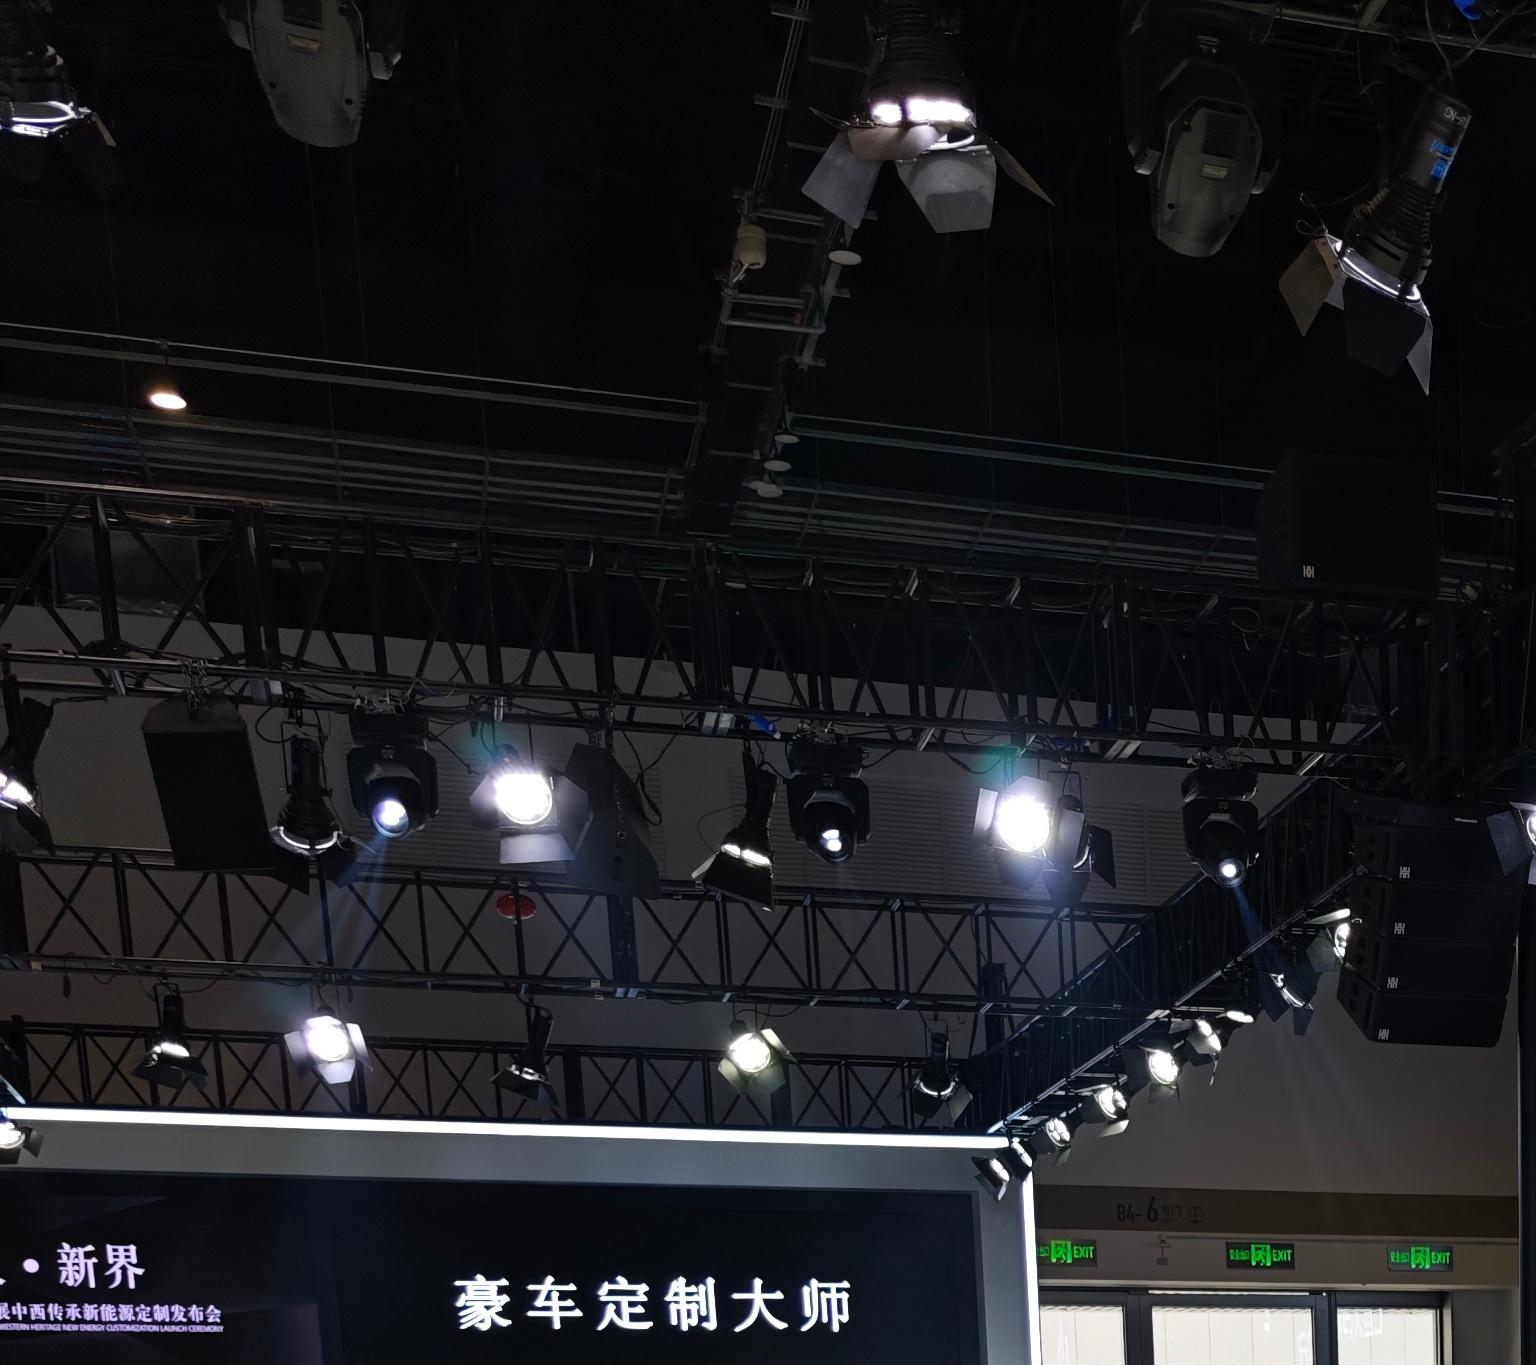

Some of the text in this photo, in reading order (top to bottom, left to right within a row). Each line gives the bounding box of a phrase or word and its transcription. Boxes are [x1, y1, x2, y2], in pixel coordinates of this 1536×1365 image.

[1073, 1246, 1095, 1259] EXIT
[1272, 1249, 1293, 1262] EXIT
[1431, 1251, 1451, 1265] EXIT
[453, 1273, 851, 1332] 豪车定制大师
